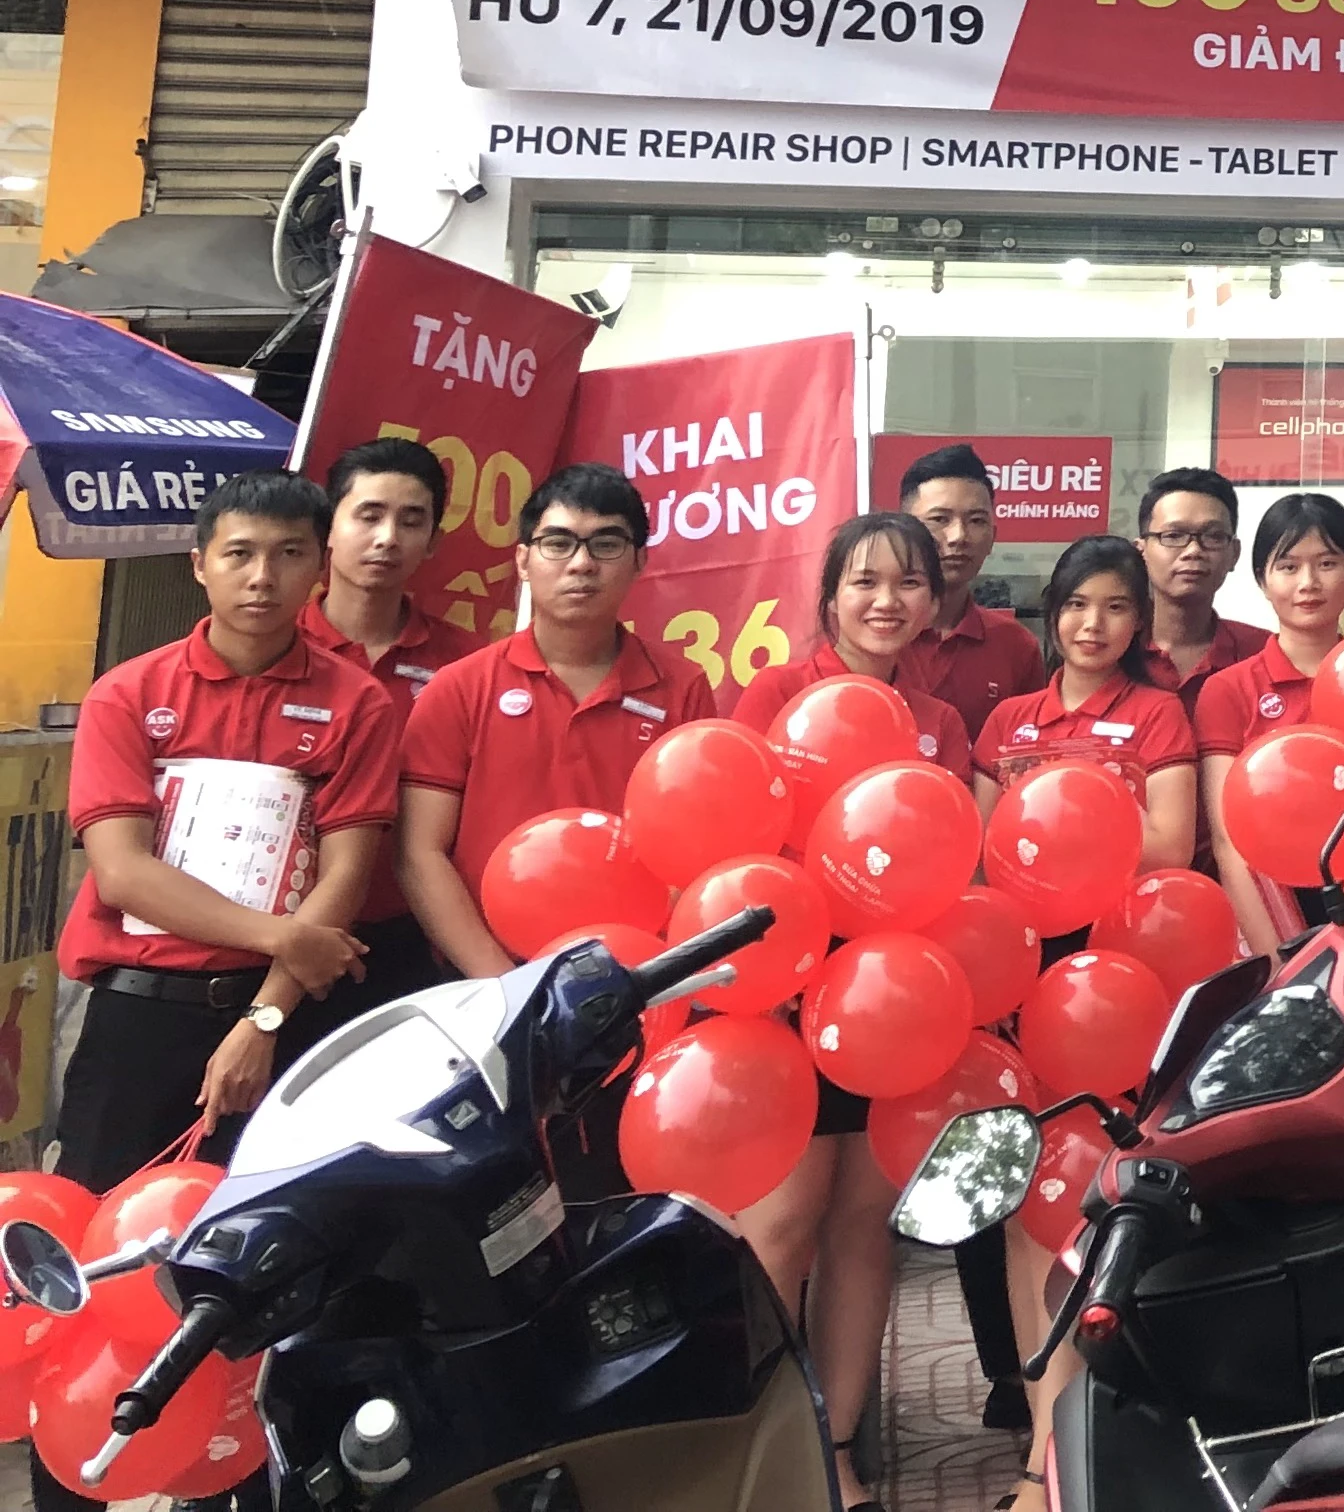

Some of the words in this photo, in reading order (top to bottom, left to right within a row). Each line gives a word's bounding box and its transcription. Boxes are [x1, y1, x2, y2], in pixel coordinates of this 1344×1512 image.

[1192, 24, 1321, 73] GIẢM
[489, 123, 628, 157] PHONE
[638, 127, 776, 162] REPAIR
[785, 131, 893, 166] SHOP
[920, 137, 1180, 174] SMARTPHONE
[1208, 146, 1339, 178] TABLET
[411, 310, 538, 399] TẶNG
[50, 408, 266, 440] SAMSUNG
[621, 411, 764, 481] KHAI
[64, 460, 150, 512] GIÁ
[153, 459, 205, 511] RẺ
[1063, 457, 1102, 493] RẺ
[643, 477, 818, 548] ƯƠNG
[994, 500, 1049, 520] CHÍNH
[1052, 501, 1100, 520] HÃNG
[623, 598, 790, 691] 36
